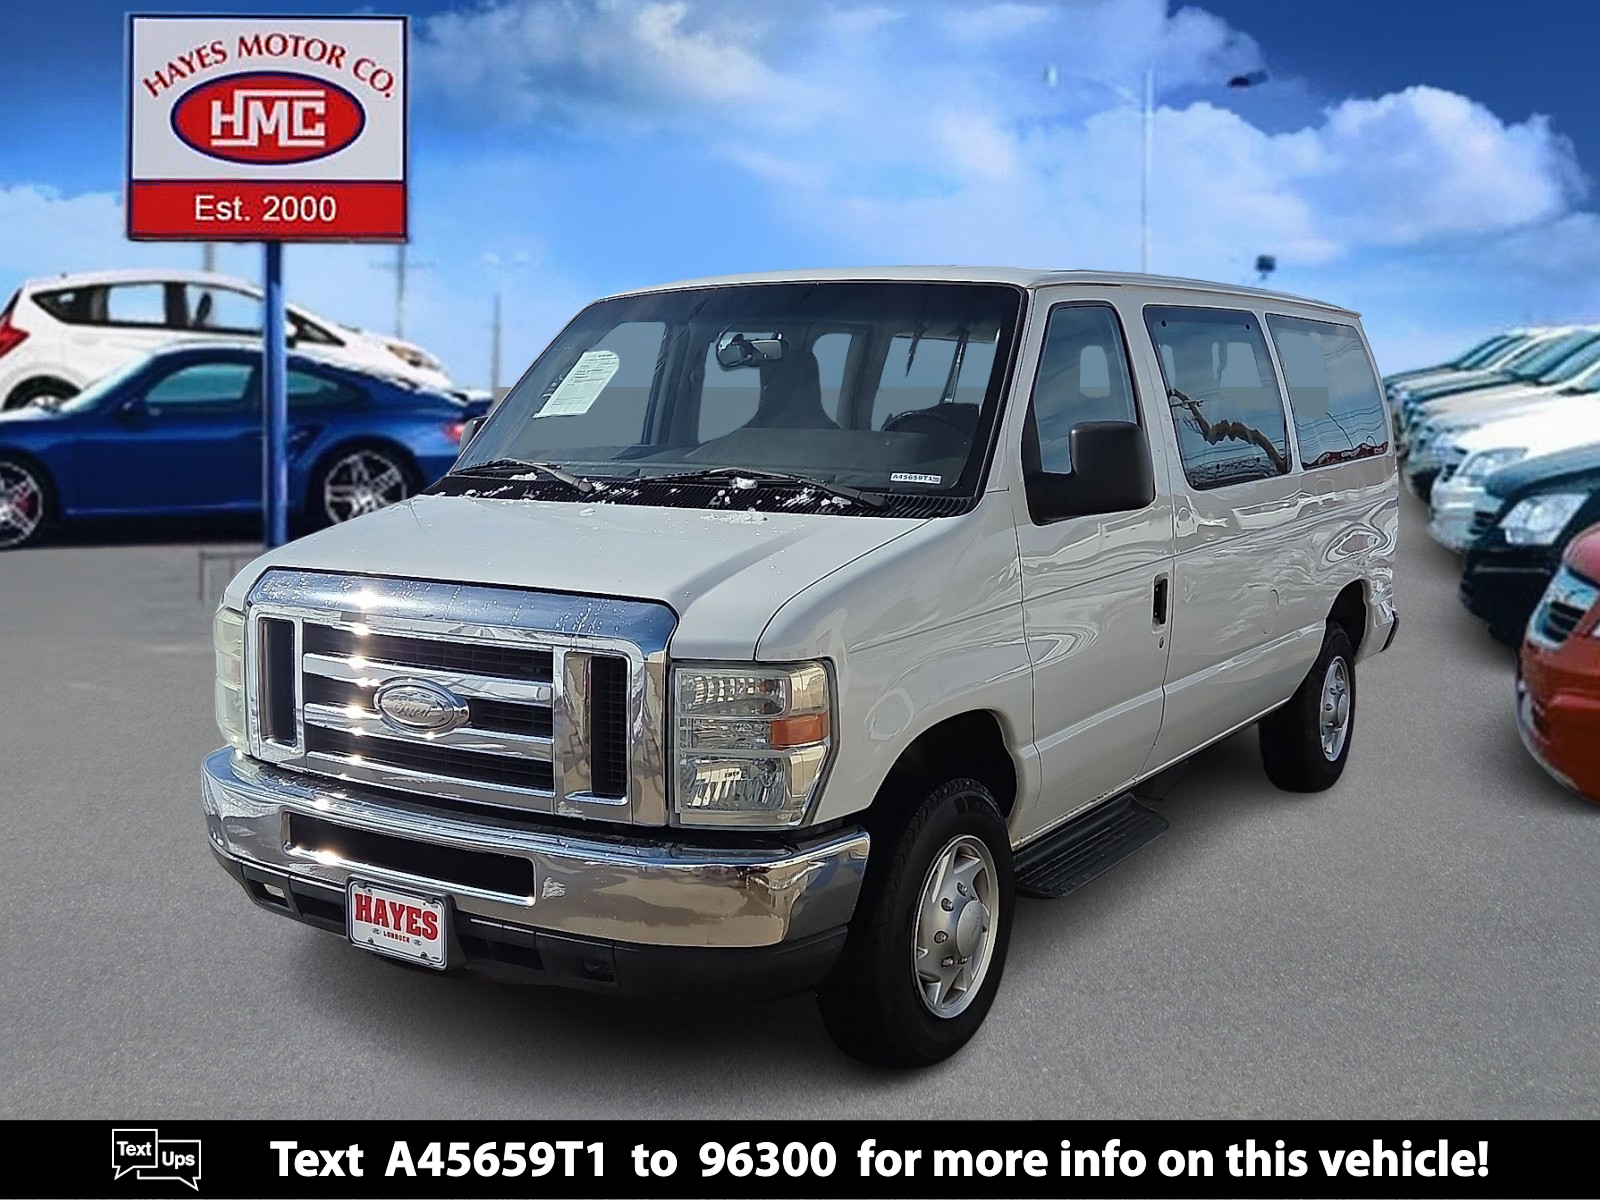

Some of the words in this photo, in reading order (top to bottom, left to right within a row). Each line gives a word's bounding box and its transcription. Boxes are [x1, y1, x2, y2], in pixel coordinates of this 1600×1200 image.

[142, 40, 228, 97] HAYES
[237, 32, 347, 70] MOTOR
[352, 57, 395, 98] CO.
[210, 89, 326, 147] HMC
[194, 194, 251, 222] Est.
[262, 195, 337, 222] 2000
[355, 893, 438, 941] HAYES
